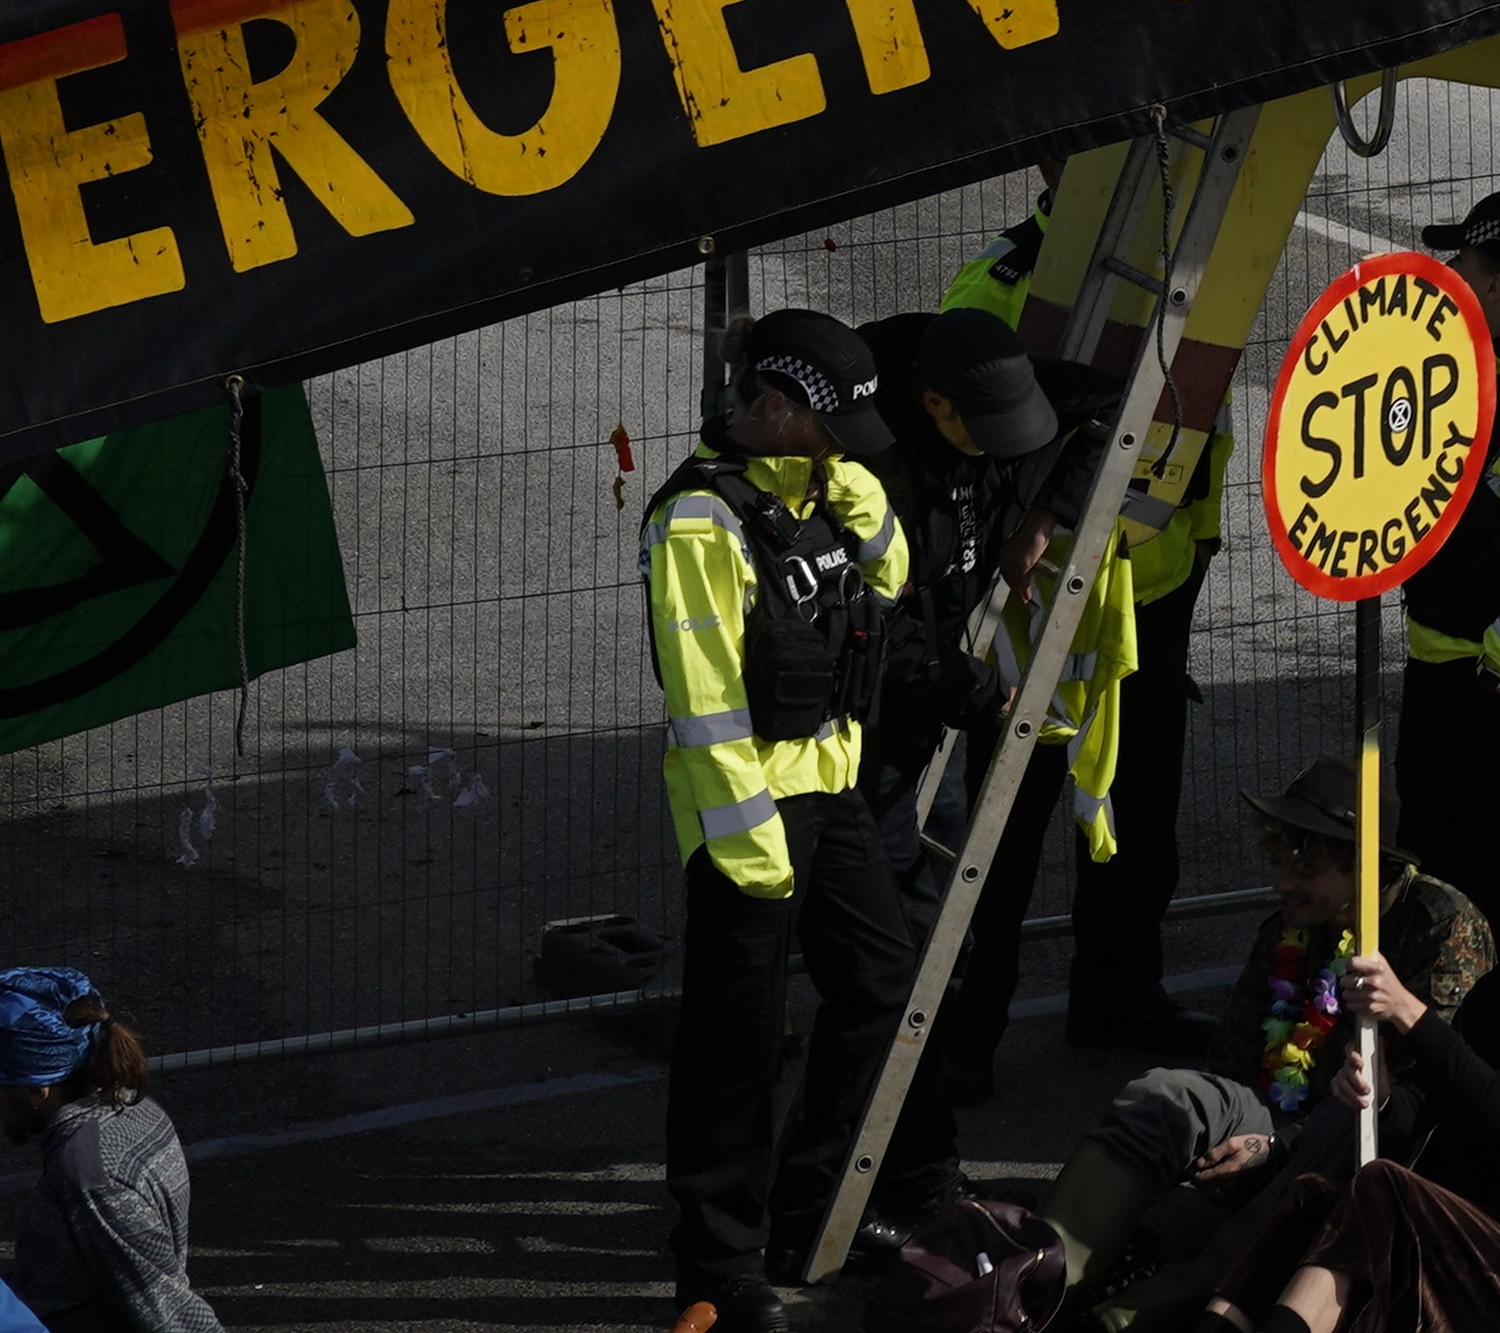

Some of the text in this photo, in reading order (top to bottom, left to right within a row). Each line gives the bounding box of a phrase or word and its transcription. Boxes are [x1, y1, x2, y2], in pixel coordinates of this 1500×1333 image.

[1304, 274, 1459, 375] CLIMATE
[1299, 354, 1460, 499] STOP
[815, 546, 849, 573] POLICE
[1287, 420, 1476, 579] EMERGENCY
